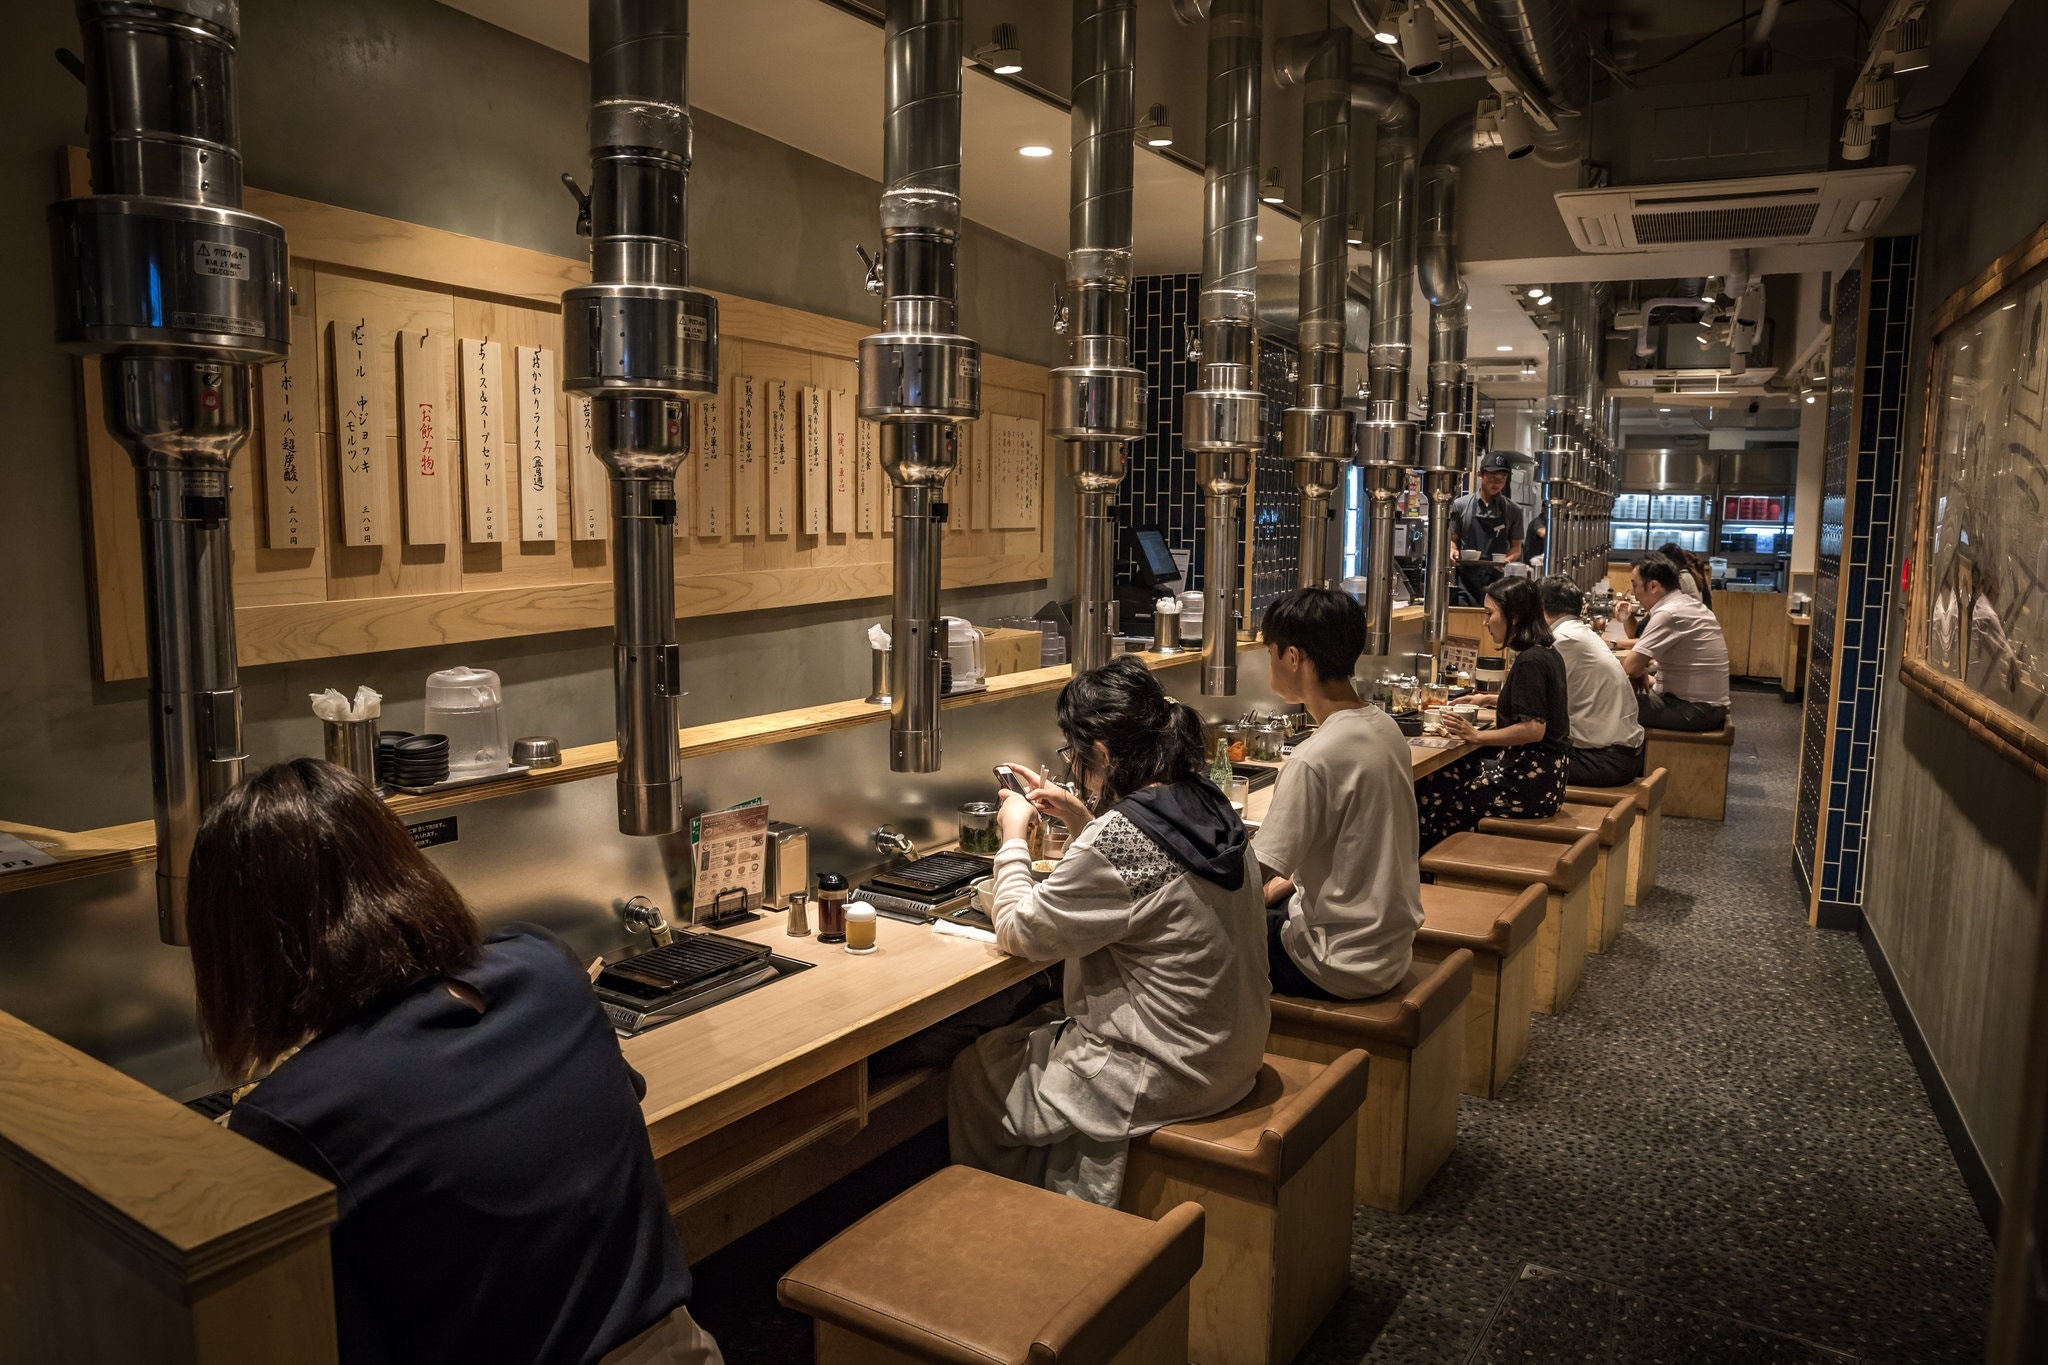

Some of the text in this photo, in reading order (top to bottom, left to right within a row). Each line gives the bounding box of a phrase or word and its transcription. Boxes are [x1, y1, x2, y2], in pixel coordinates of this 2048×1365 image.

[354, 334, 371, 474] ビール 中ジョッキ
[418, 402, 436, 477] 【お飲み物】
[478, 347, 491, 487] ライス&スープセット
[582, 398, 593, 455] 苔スープ
[710, 402, 718, 460] チョウ単品
